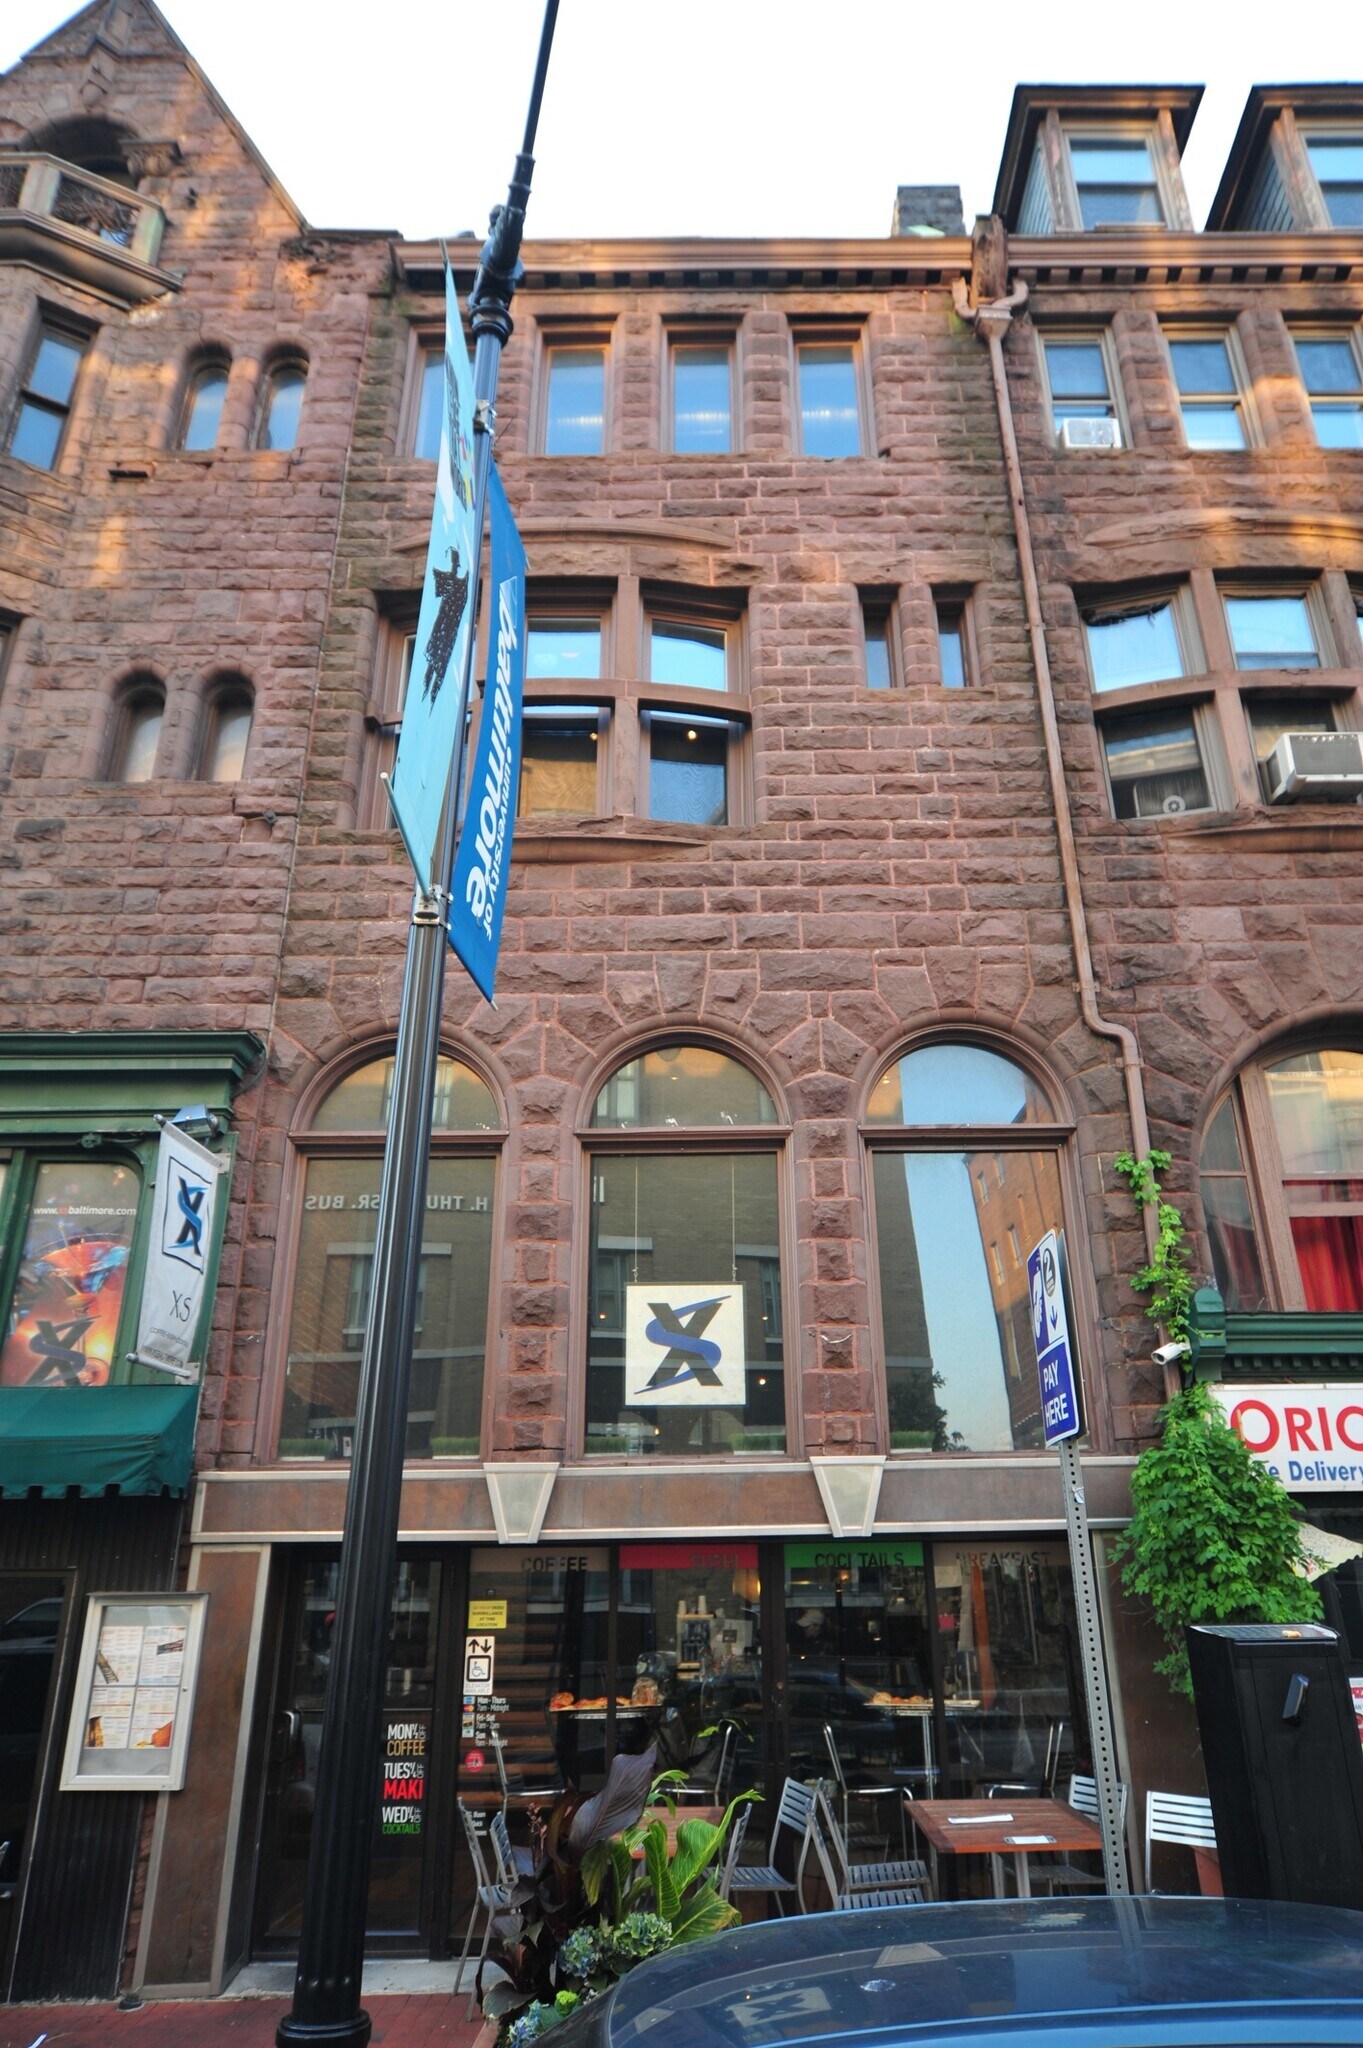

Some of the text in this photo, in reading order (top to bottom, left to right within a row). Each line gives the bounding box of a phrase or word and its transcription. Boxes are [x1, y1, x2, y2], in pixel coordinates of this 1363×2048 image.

[483, 763, 512, 941] university of
[1044, 1250, 1053, 1282] 2
[170, 1290, 192, 1322] XS
[1043, 1360, 1059, 1392] PAY
[1045, 1393, 1069, 1428] HERE
[521, 1556, 588, 1573] COFFEE
[814, 1552, 905, 1568] COCKTAILS
[388, 1724, 411, 1740] MON
[387, 1740, 426, 1756] COFFEE
[384, 1763, 410, 1779] TUES
[384, 1780, 424, 1799] MAKI
[382, 1806, 408, 1823] WED
[382, 1824, 421, 1834] COCKTAILS
